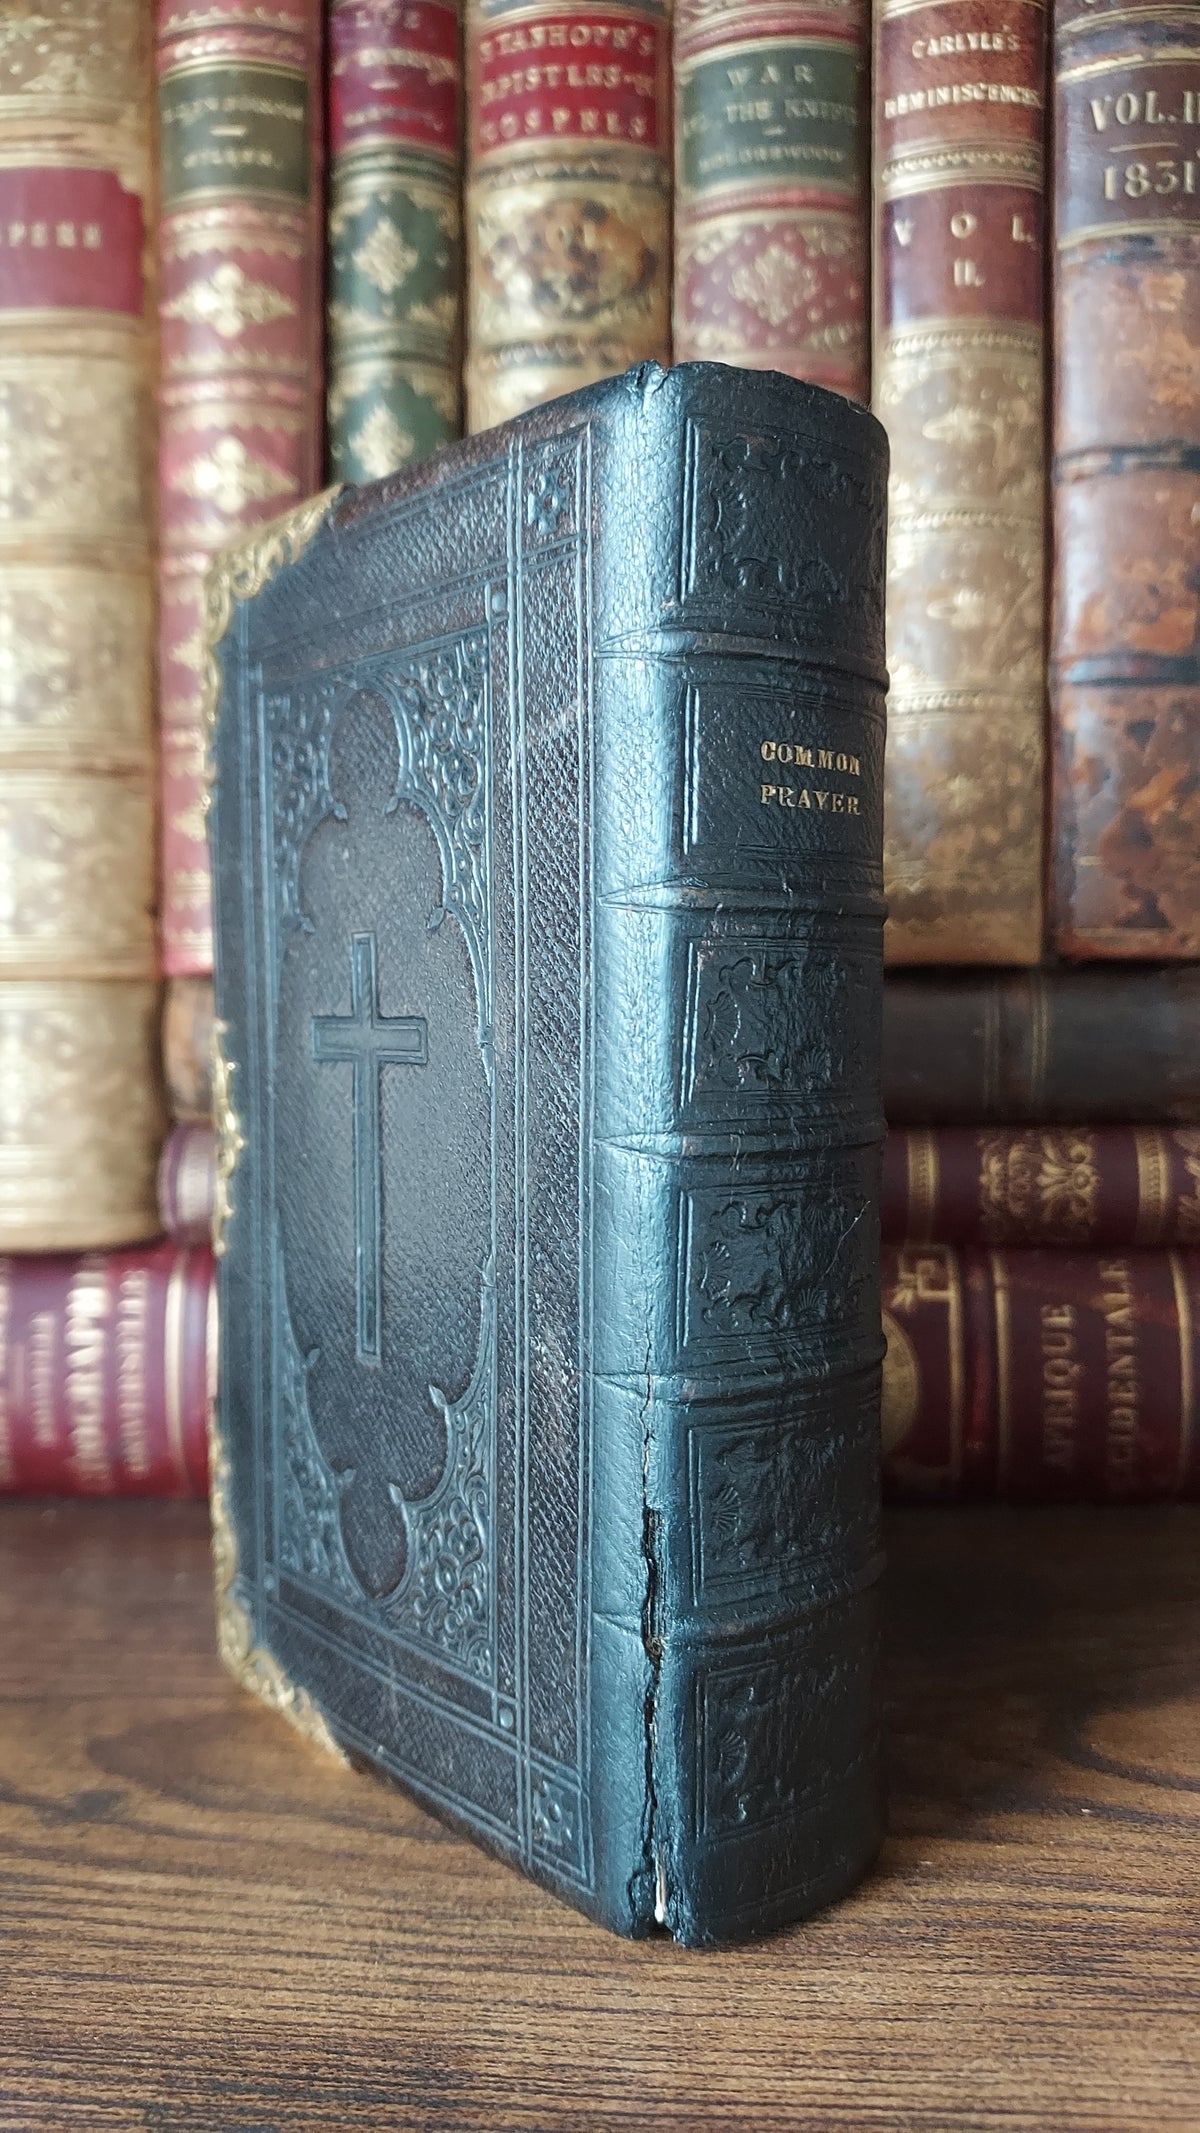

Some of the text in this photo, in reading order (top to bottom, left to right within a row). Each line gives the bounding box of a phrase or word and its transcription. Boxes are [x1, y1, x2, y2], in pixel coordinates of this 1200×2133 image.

[912, 25, 1020, 59] CARLYLE'S
[727, 64, 815, 86] WAR
[1104, 160, 1196, 200] 1831
[761, 741, 860, 776] COMMON
[761, 784, 861, 815] PRAYER
